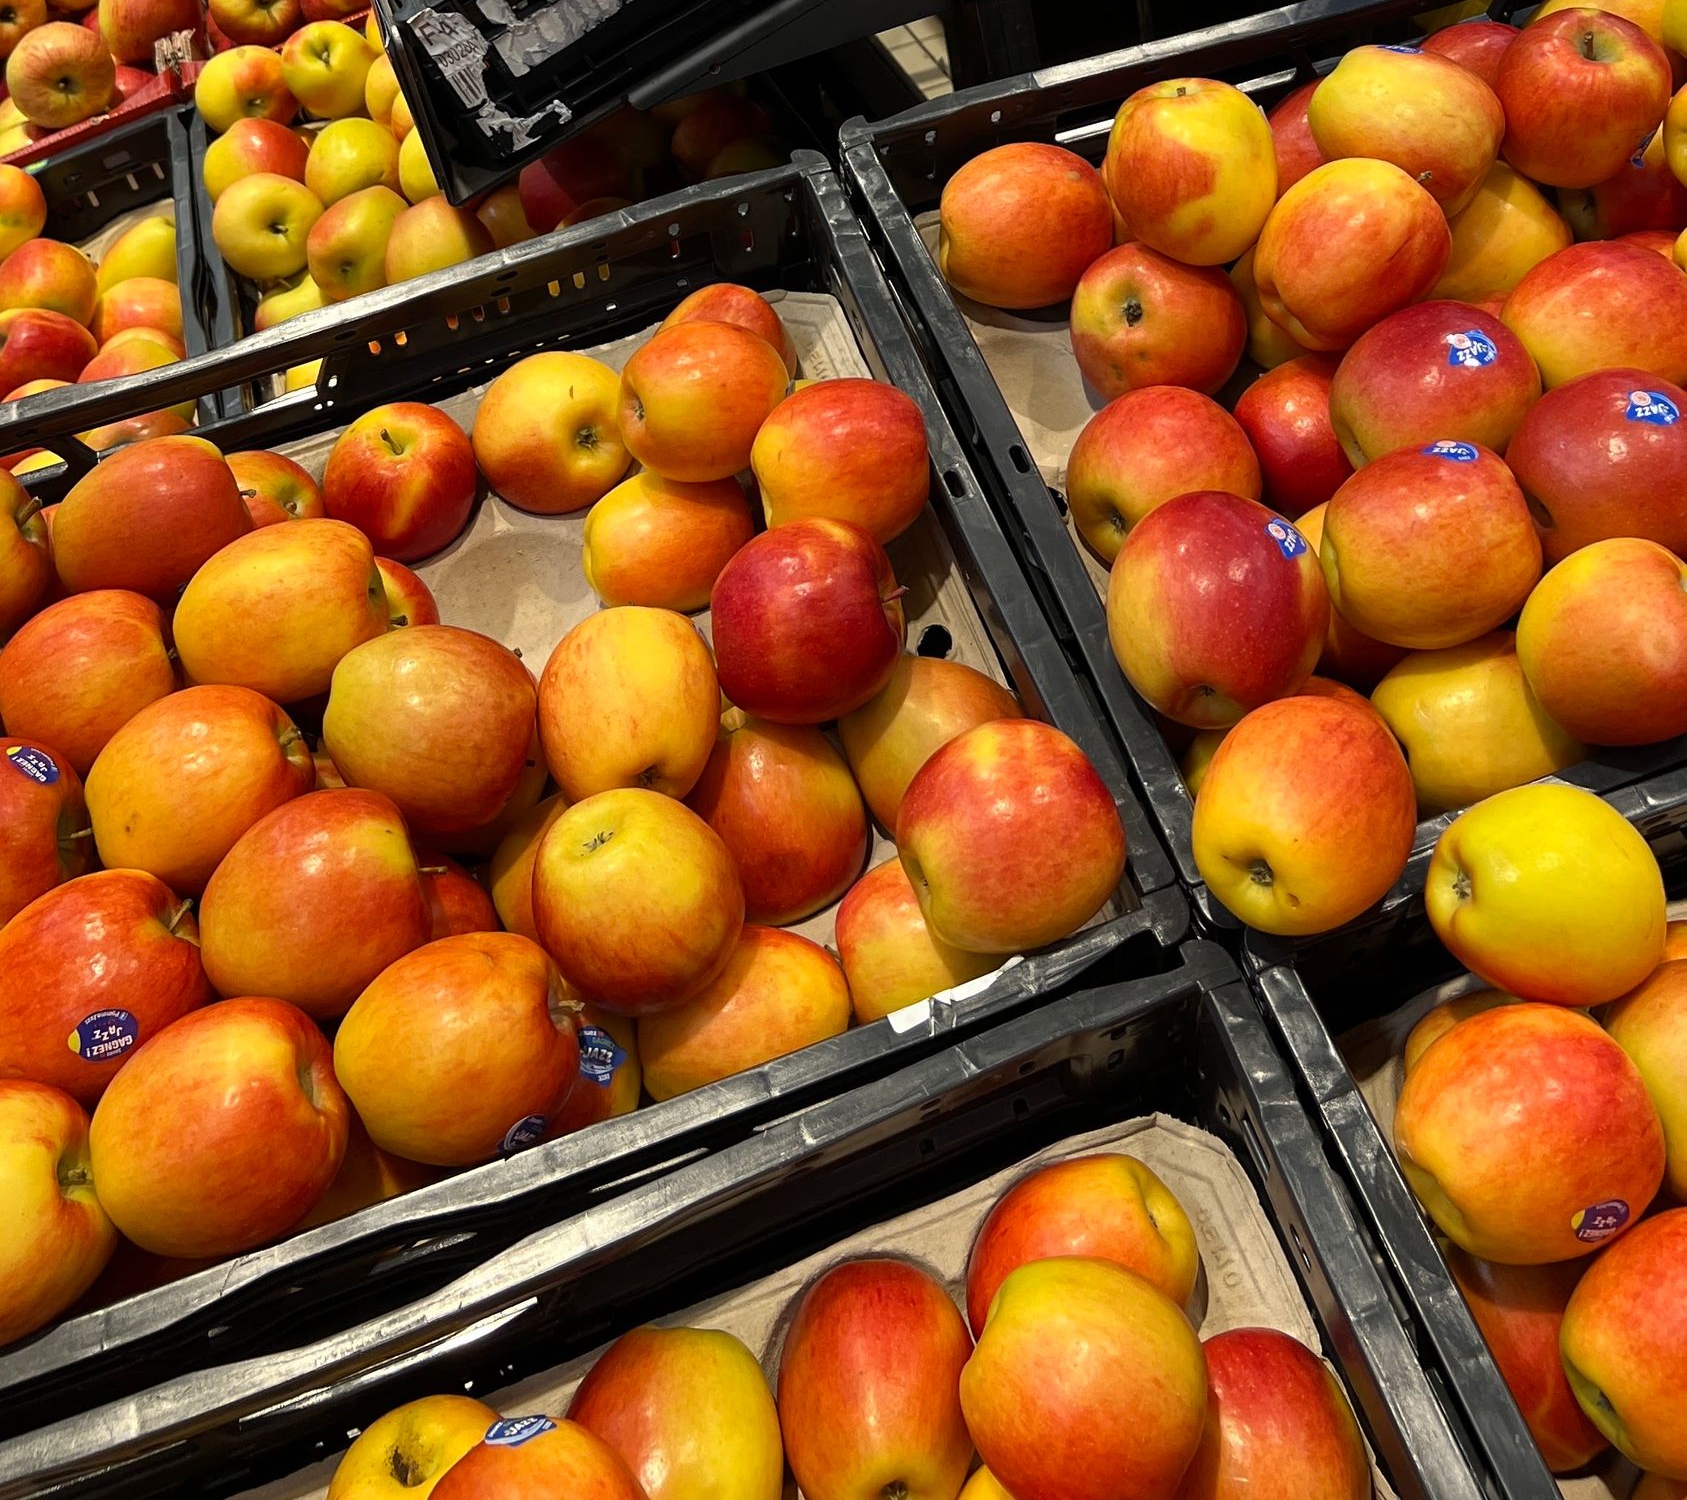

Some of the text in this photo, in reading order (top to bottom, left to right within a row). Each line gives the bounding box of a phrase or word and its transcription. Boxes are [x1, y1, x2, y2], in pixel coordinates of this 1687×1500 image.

[1634, 403, 1666, 418] JAZZ
[93, 1024, 123, 1041] JAZZ
[582, 1047, 613, 1063] JAZZ
[509, 1417, 538, 1435] JAZZ
